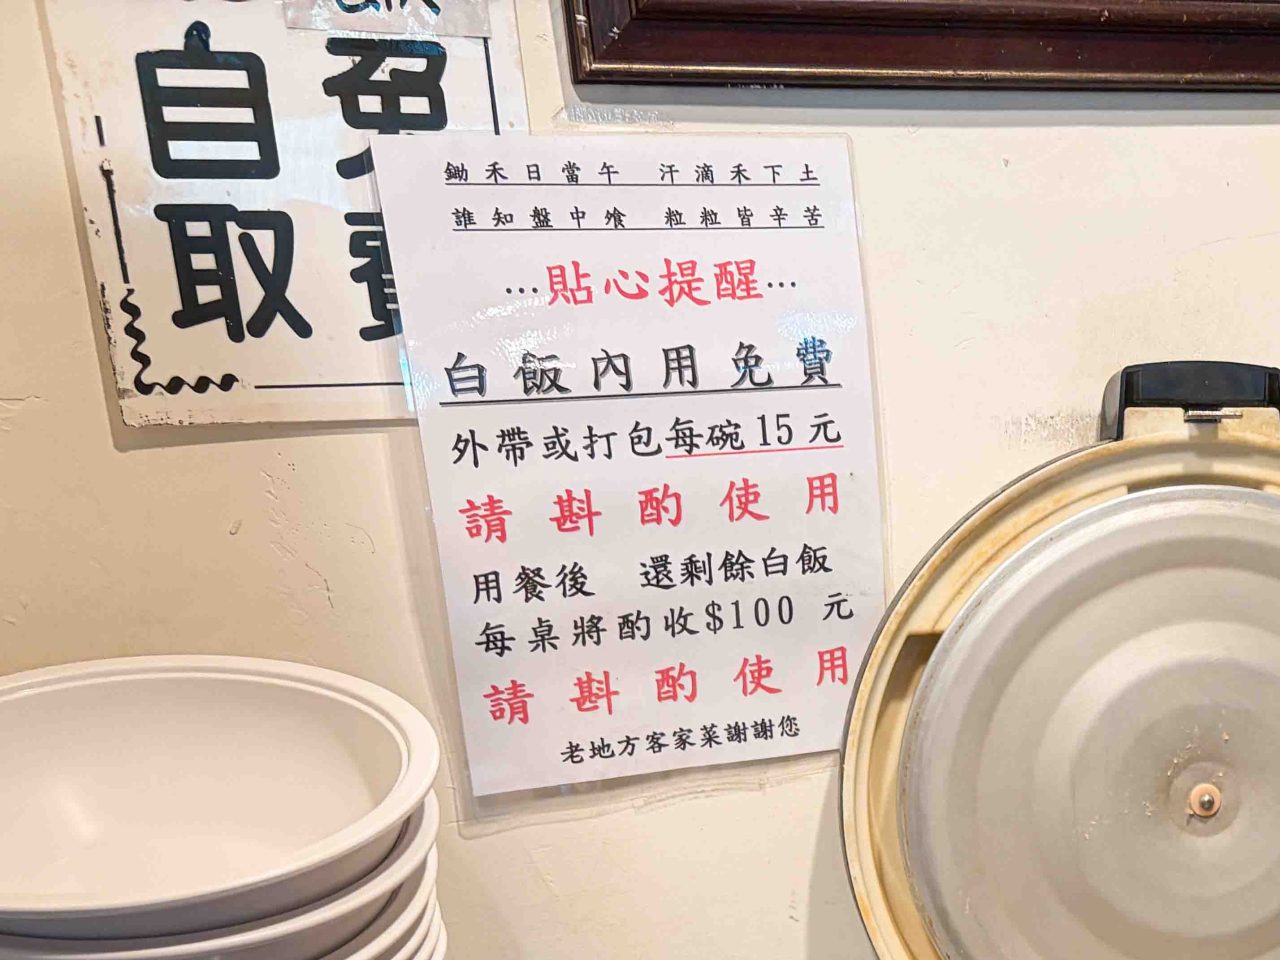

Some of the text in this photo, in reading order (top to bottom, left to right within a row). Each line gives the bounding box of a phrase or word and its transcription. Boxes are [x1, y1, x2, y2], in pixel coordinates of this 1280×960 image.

[135, 20, 312, 343] 自取
[659, 162, 818, 183] 汗滴禾下土
[664, 205, 824, 228] 粒粒皆辛苦
[458, 472, 840, 544] 請斟酌使用
[473, 543, 834, 604] 用餐後 還剩餘白飯
[482, 646, 850, 725] 請斟酌使用
[560, 715, 801, 764] 老地方客家菜謝謝您
